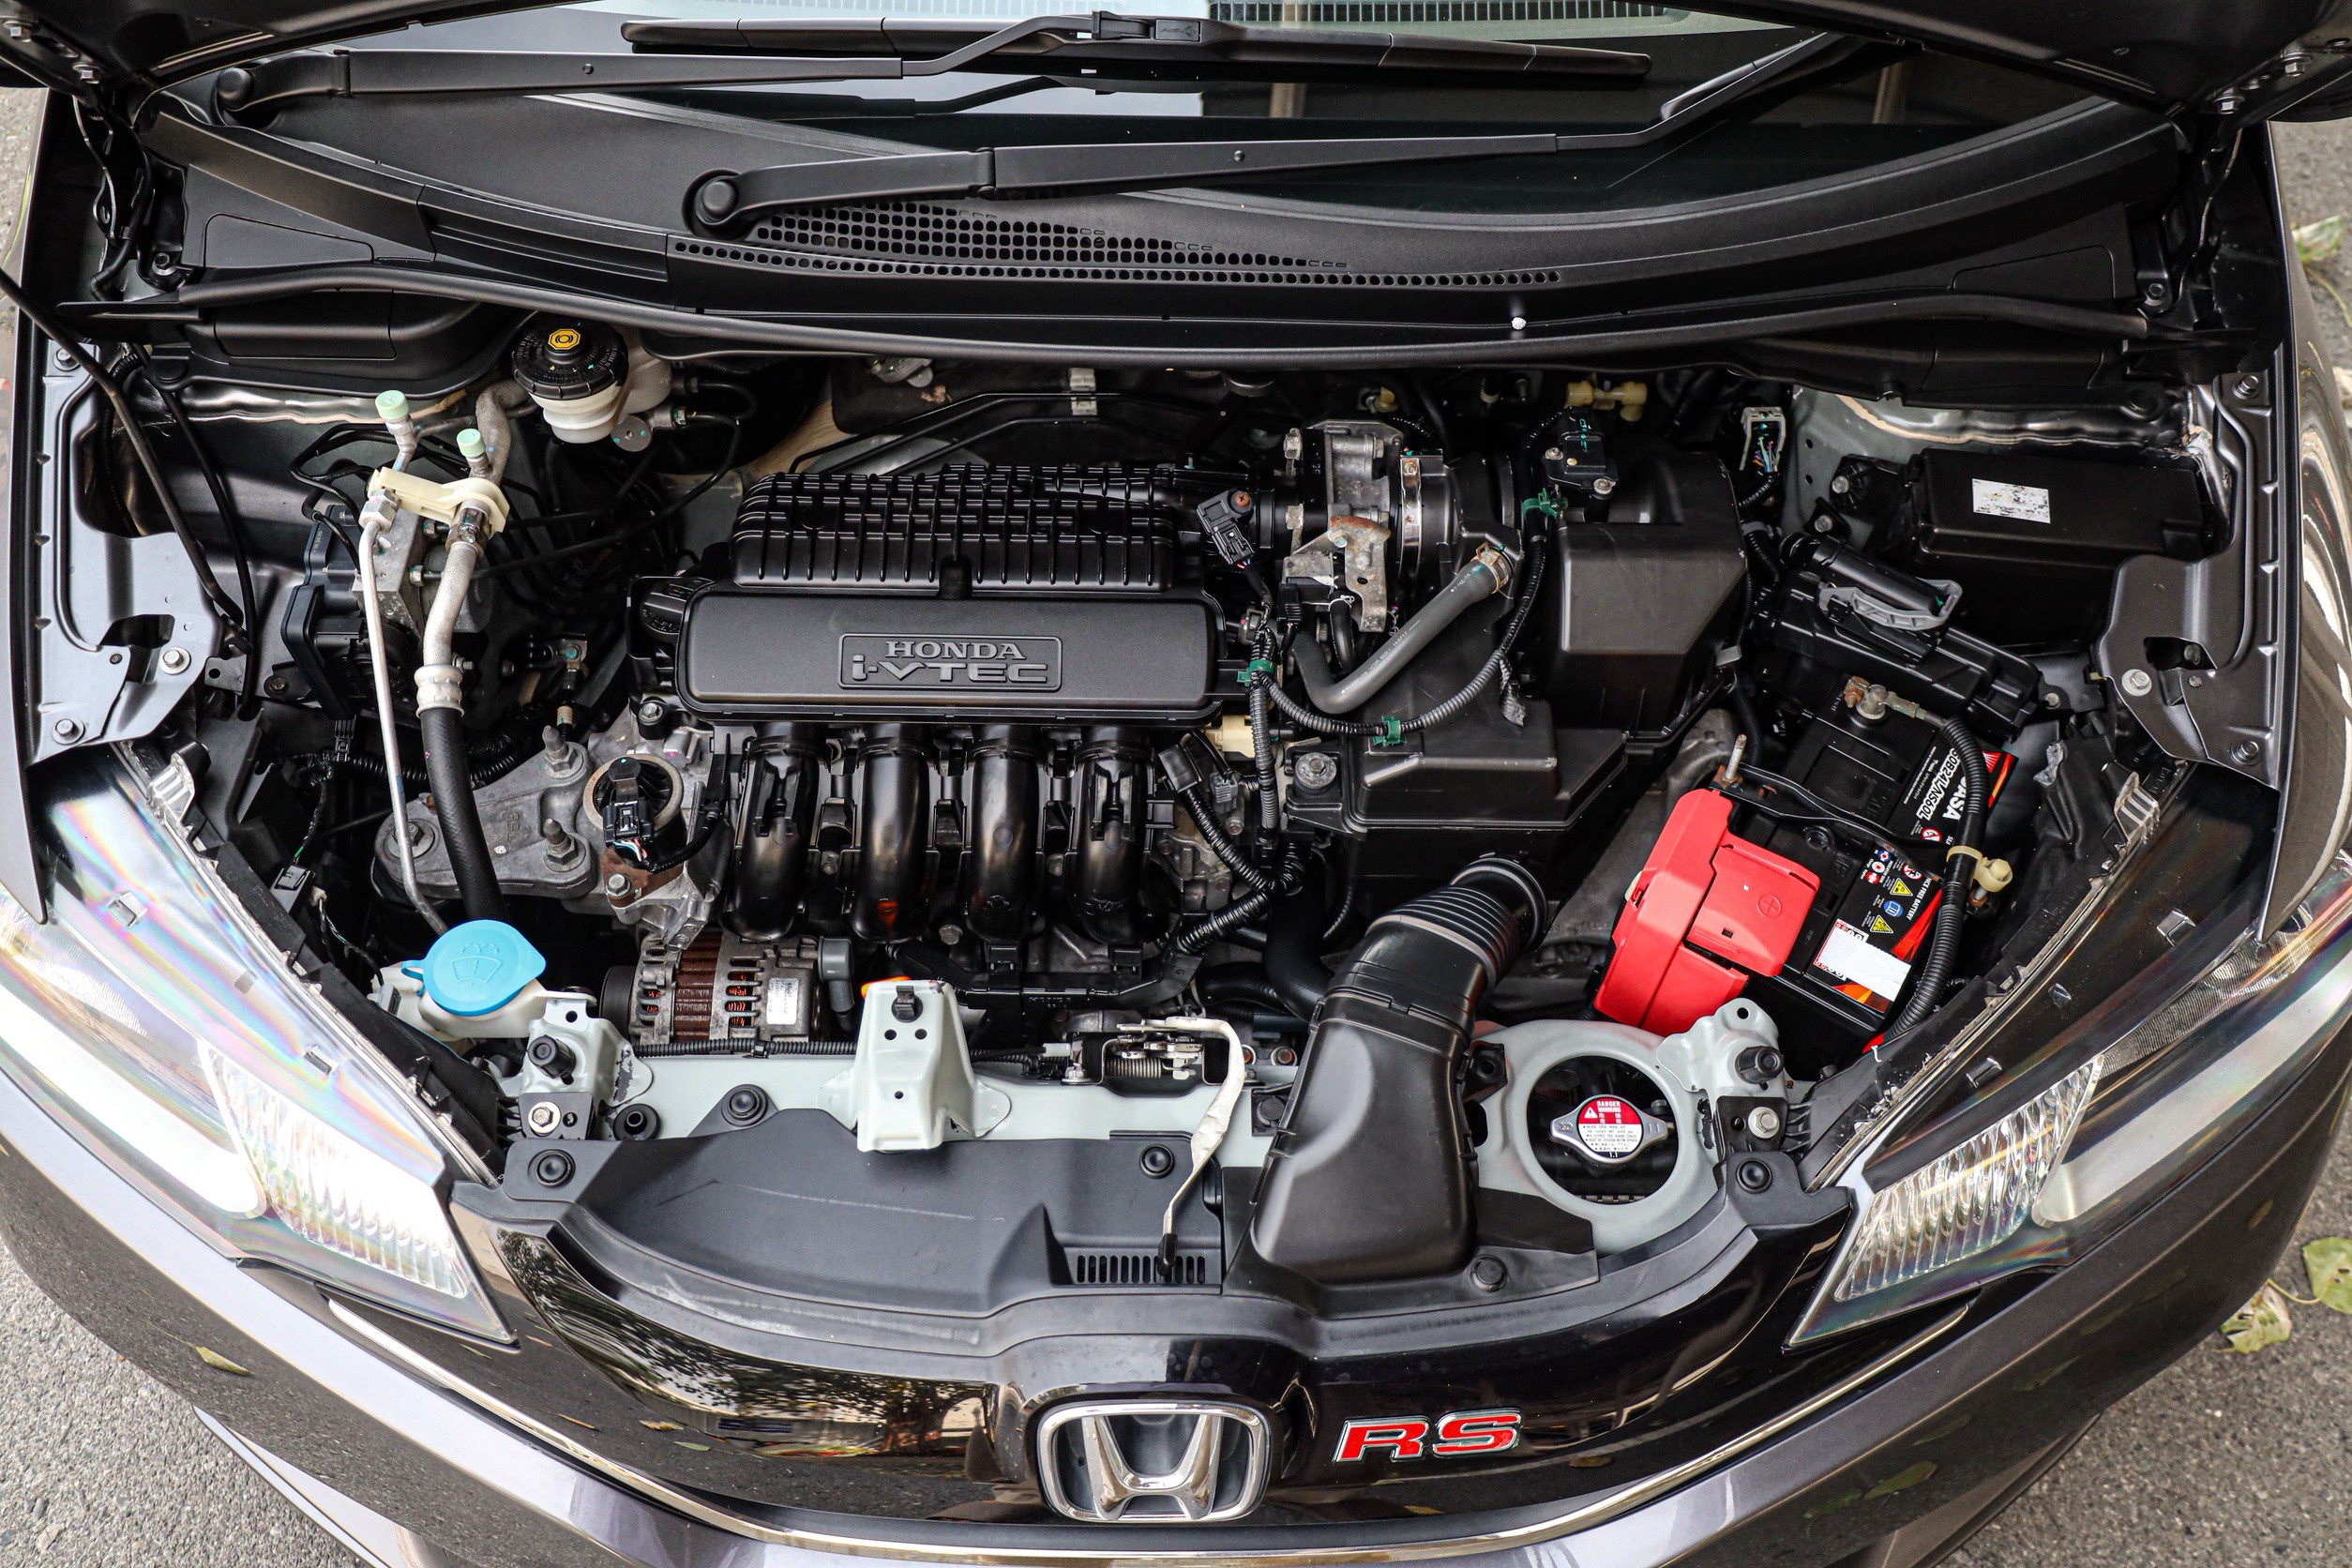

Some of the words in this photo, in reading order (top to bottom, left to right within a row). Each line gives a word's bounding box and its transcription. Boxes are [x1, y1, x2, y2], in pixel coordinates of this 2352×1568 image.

[885, 641, 1026, 660] HONDA
[852, 654, 1048, 683] i-VTEC
[1942, 776, 1967, 821] ASA
[1916, 886, 1927, 899] FREE
[1905, 897, 1921, 920] BATTERY
[1332, 1407, 1522, 1463] RS
